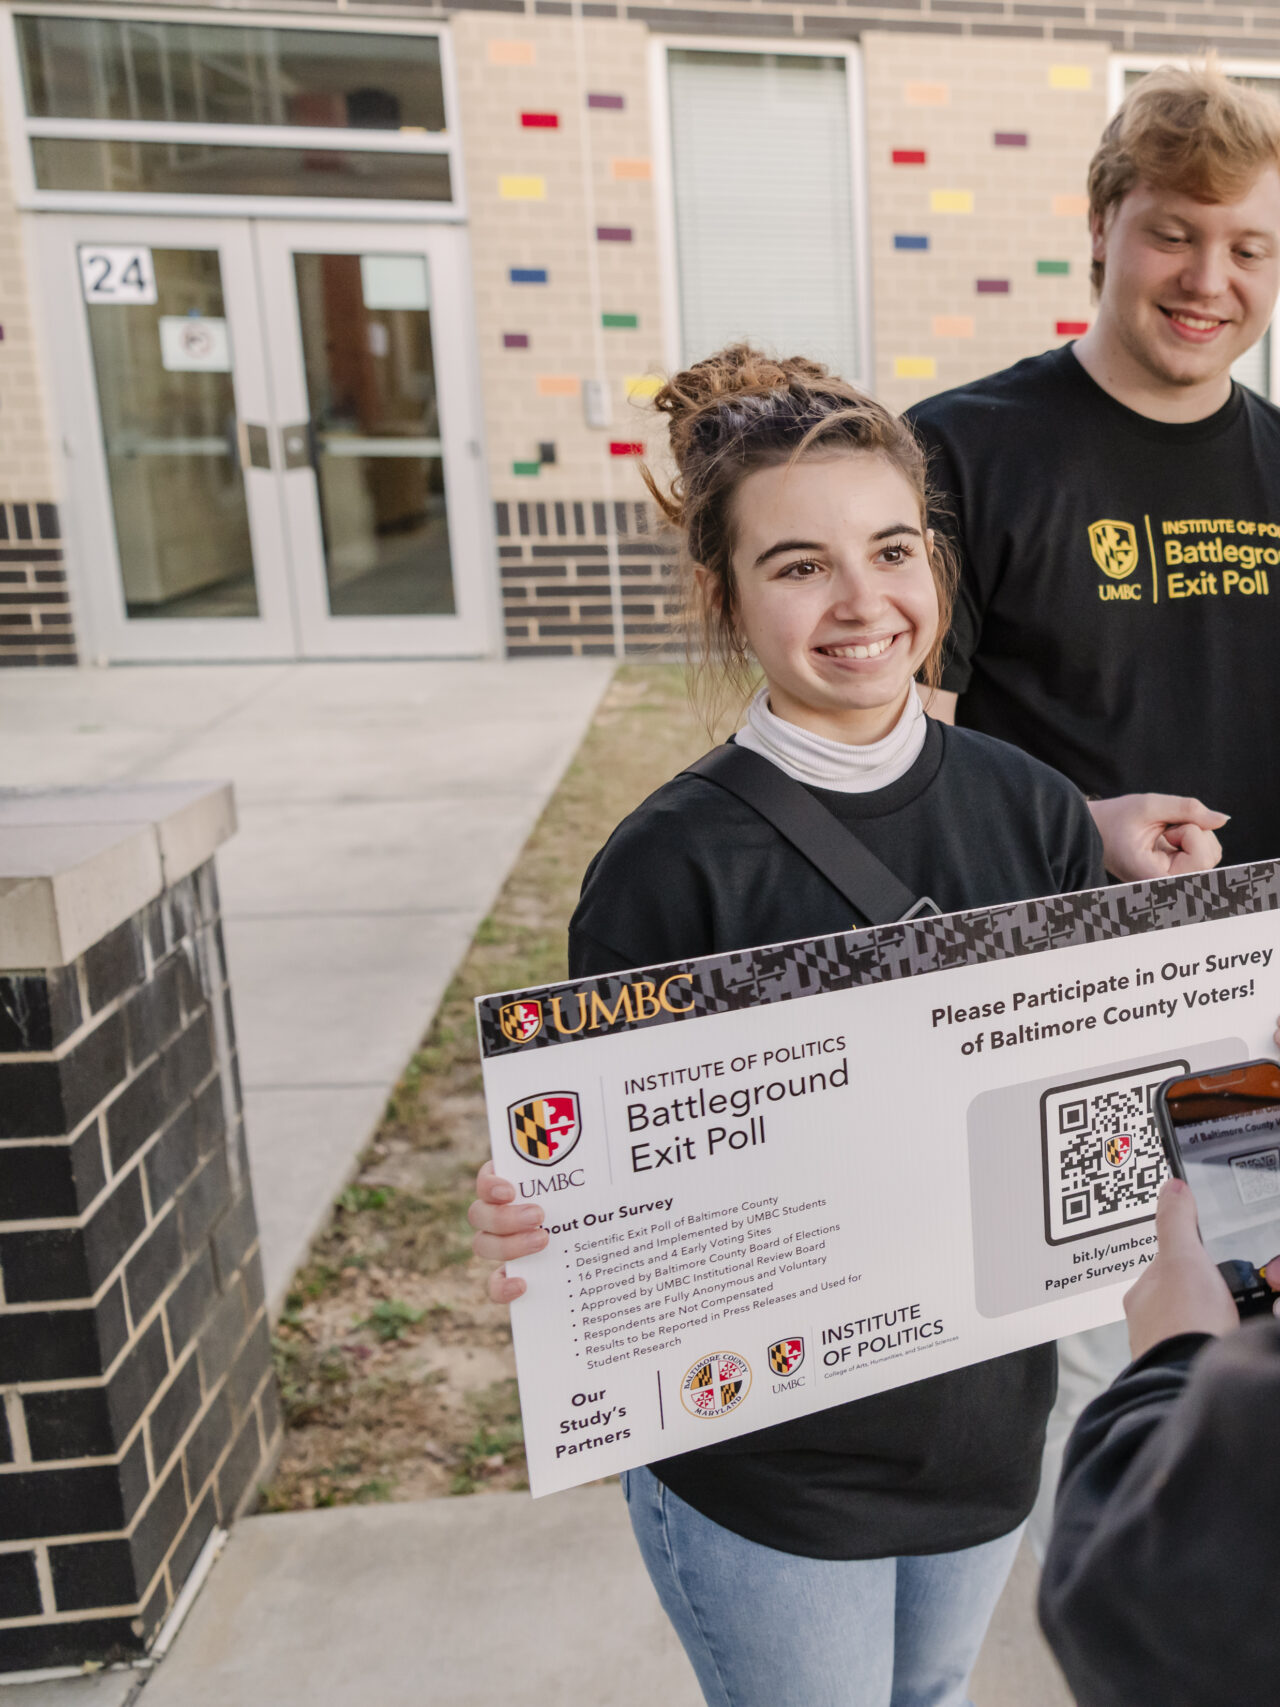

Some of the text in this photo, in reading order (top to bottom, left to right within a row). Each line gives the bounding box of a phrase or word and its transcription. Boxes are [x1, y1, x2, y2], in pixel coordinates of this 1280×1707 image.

[88, 255, 147, 293] 24
[1162, 519, 1235, 535] INSTITUTE
[1236, 520, 1256, 535] OF
[1098, 584, 1142, 601] UMBC
[1167, 570, 1269, 599] Exit Poll
[548, 973, 695, 1035] UMBC
[931, 948, 1274, 1028] Please Participate in Our Survey
[960, 979, 1256, 1056] of Baltimore County Voters!
[624, 1036, 847, 1095] INSTITUTE OF POLITICS
[627, 1057, 849, 1133] Battleground
[631, 1115, 766, 1173] Exit Poll
[1189, 1134, 1199, 1144] of
[1200, 1126, 1243, 1141] Baltimore
[1245, 1119, 1274, 1133] County
[518, 1168, 586, 1199] UMBC
[574, 1196, 779, 1252] Scientific Exit Poll of Baltimore County
[576, 1199, 827, 1267] Designed and Implemented by UMBC Students
[583, 1213, 615, 1226] Our
[619, 1197, 674, 1218] Survey
[579, 1226, 772, 1281] 16 Precincts and 4 Early Voting Sites
[579, 1224, 841, 1297] Approved by Baltimore County Board of Elections
[1045, 1272, 1083, 1290] Paper
[1086, 1258, 1135, 1279] Surveys
[581, 1240, 826, 1312] Approved by UMBC Institutional Review Board
[582, 1256, 827, 1326] Responses are Fully Anonymous and Voluntary
[584, 1282, 774, 1340] Respondents are Not Compensated
[585, 1273, 862, 1355] Results to be Reported in Press Releases and Used for
[822, 1303, 921, 1345] INSTITUTE
[587, 1337, 682, 1370] Student Research
[823, 1319, 944, 1366] OF POLITICS
[683, 1354, 748, 1390] BALTIMORE COUNTY
[772, 1376, 806, 1394] UMBC
[571, 1389, 606, 1407] Our
[694, 1395, 742, 1416] MARYLAND
[555, 1429, 631, 1459] Partners
